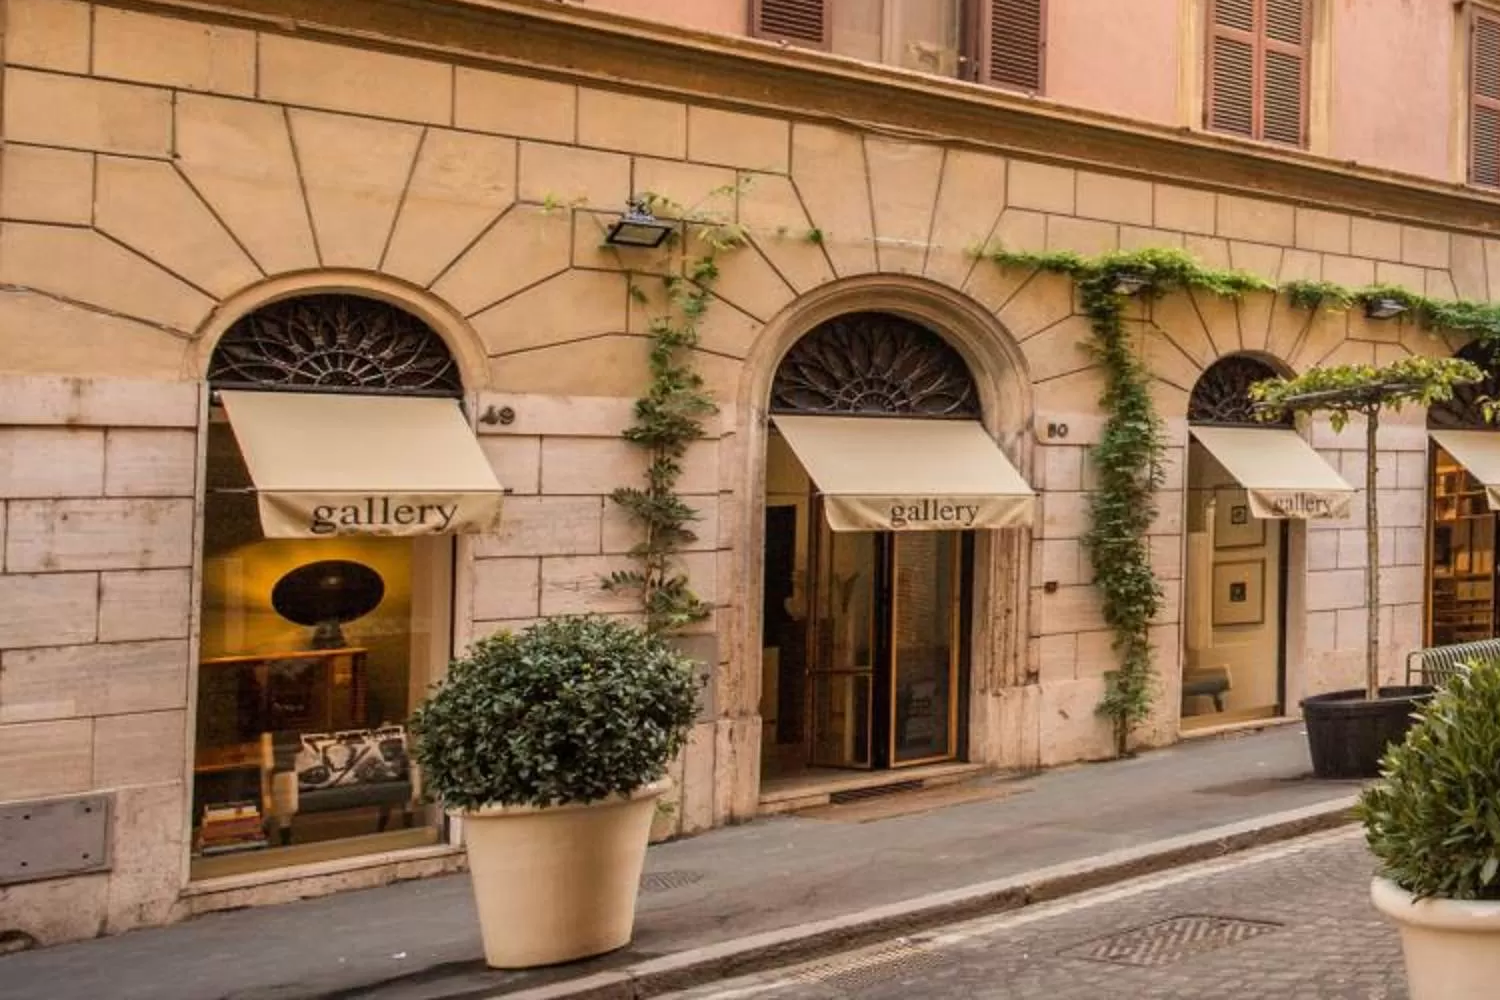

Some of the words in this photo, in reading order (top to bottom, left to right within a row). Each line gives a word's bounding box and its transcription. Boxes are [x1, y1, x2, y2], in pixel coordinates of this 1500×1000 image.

[479, 405, 516, 426] 49
[309, 496, 458, 535] gallery
[889, 498, 980, 528] gallery
